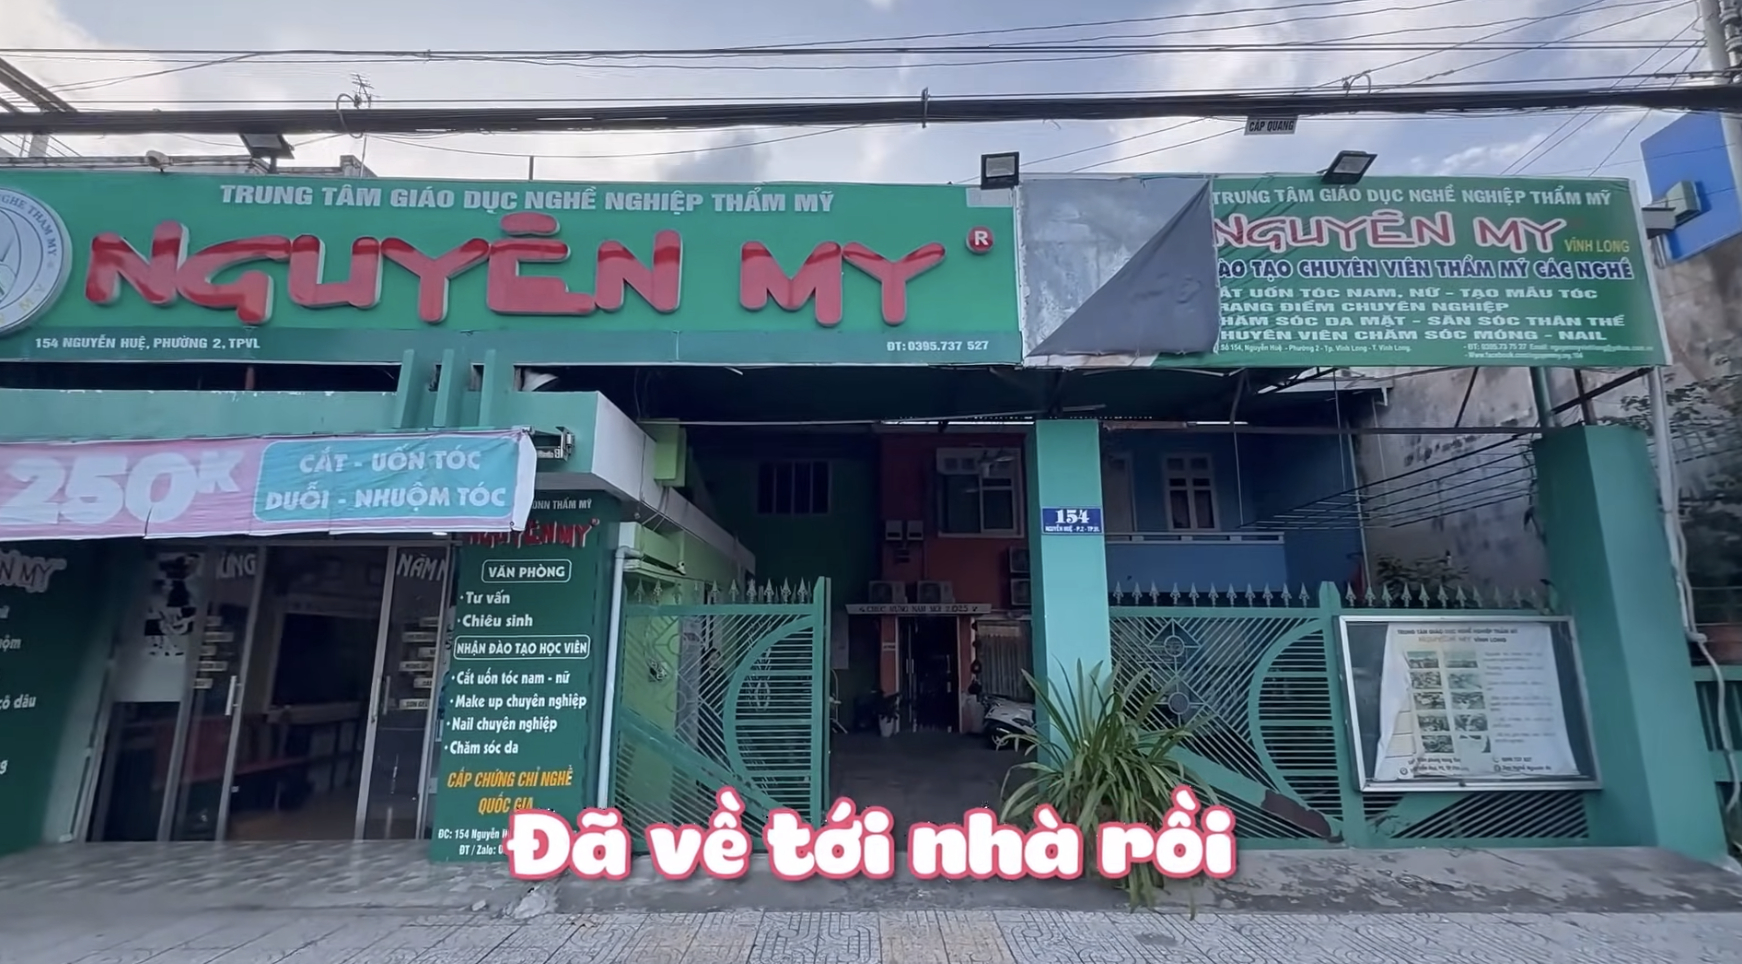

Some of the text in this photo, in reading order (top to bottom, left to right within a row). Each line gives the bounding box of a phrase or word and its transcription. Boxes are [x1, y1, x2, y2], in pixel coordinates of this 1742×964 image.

[1267, 121, 1294, 132] QUANG
[220, 184, 834, 215] TRUNG TÂM GIÁO DỤC NGHỀ NGHIỆP THẨM MỸ
[1212, 184, 1611, 206] TRUNG TÂM GIÁO DỤC NGHỀ NGHIỆP THẨM MỸ
[1473, 216, 1567, 253] MY
[1596, 240, 1630, 253] LONG
[85, 211, 681, 325] NGUYÊN
[739, 240, 946, 327] MY
[1218, 258, 1247, 278] ÀO
[1250, 259, 1293, 282] TẠO
[1297, 256, 1380, 279] CHUYÊN
[1382, 256, 1433, 279] VIÊN
[1434, 254, 1496, 278] THẨM
[1533, 257, 1573, 279] CÁC
[1250, 286, 1294, 298] UỐN
[1300, 287, 1340, 298] TÓC
[1460, 288, 1499, 300] TẠO
[1558, 288, 1598, 299] TÓC
[1220, 302, 1273, 313] RANG
[1342, 301, 1425, 312] CHUYÊN
[1432, 301, 1509, 314] NGHIỆP
[1220, 315, 1269, 326] HĂM
[1276, 315, 1318, 326] SÓC
[1325, 317, 1354, 326] DA
[1360, 315, 1406, 328] MẶT
[1478, 315, 1520, 326] SÓC
[1526, 316, 1582, 327] THÂN
[35, 337, 58, 348] 154
[62, 334, 116, 348] NGUYỄN
[153, 335, 208, 349] PHƯỜNG
[229, 338, 260, 349] TPVL
[1220, 329, 1607, 341] HUYÊN VIÊN CHĂM SÓC MÓNG NAIL
[967, 340, 989, 350] 527
[300, 443, 481, 473] CẮT UỐN TÓC
[355, 481, 450, 511] NHUỘM
[457, 482, 506, 506] TÓC
[1055, 509, 1090, 524] 154
[489, 564, 565, 578] VĂN PHÒNG
[466, 589, 510, 604] Tư vấn
[462, 614, 533, 627] Chiêu sinh
[457, 640, 587, 656] NHẬN ĐÀO TẠO HỌC VIÊN
[457, 667, 571, 684] Cắt uốn tóc nam nữ
[13, 694, 36, 709] dâu
[455, 693, 587, 710] Make up chuyên nghiệp
[452, 716, 557, 733] Nail chuyên nghiệp
[450, 740, 519, 754] Chăm sóc da
[447, 767, 472, 788] CẤP
[474, 768, 516, 788] CHỨNG
[478, 792, 511, 815] QUỐC
[438, 829, 452, 839] ĐC:
[454, 829, 469, 840] 154
[471, 827, 499, 841] Nguyễn
[459, 844, 470, 855] ĐT
[476, 844, 496, 855] Zalo:
